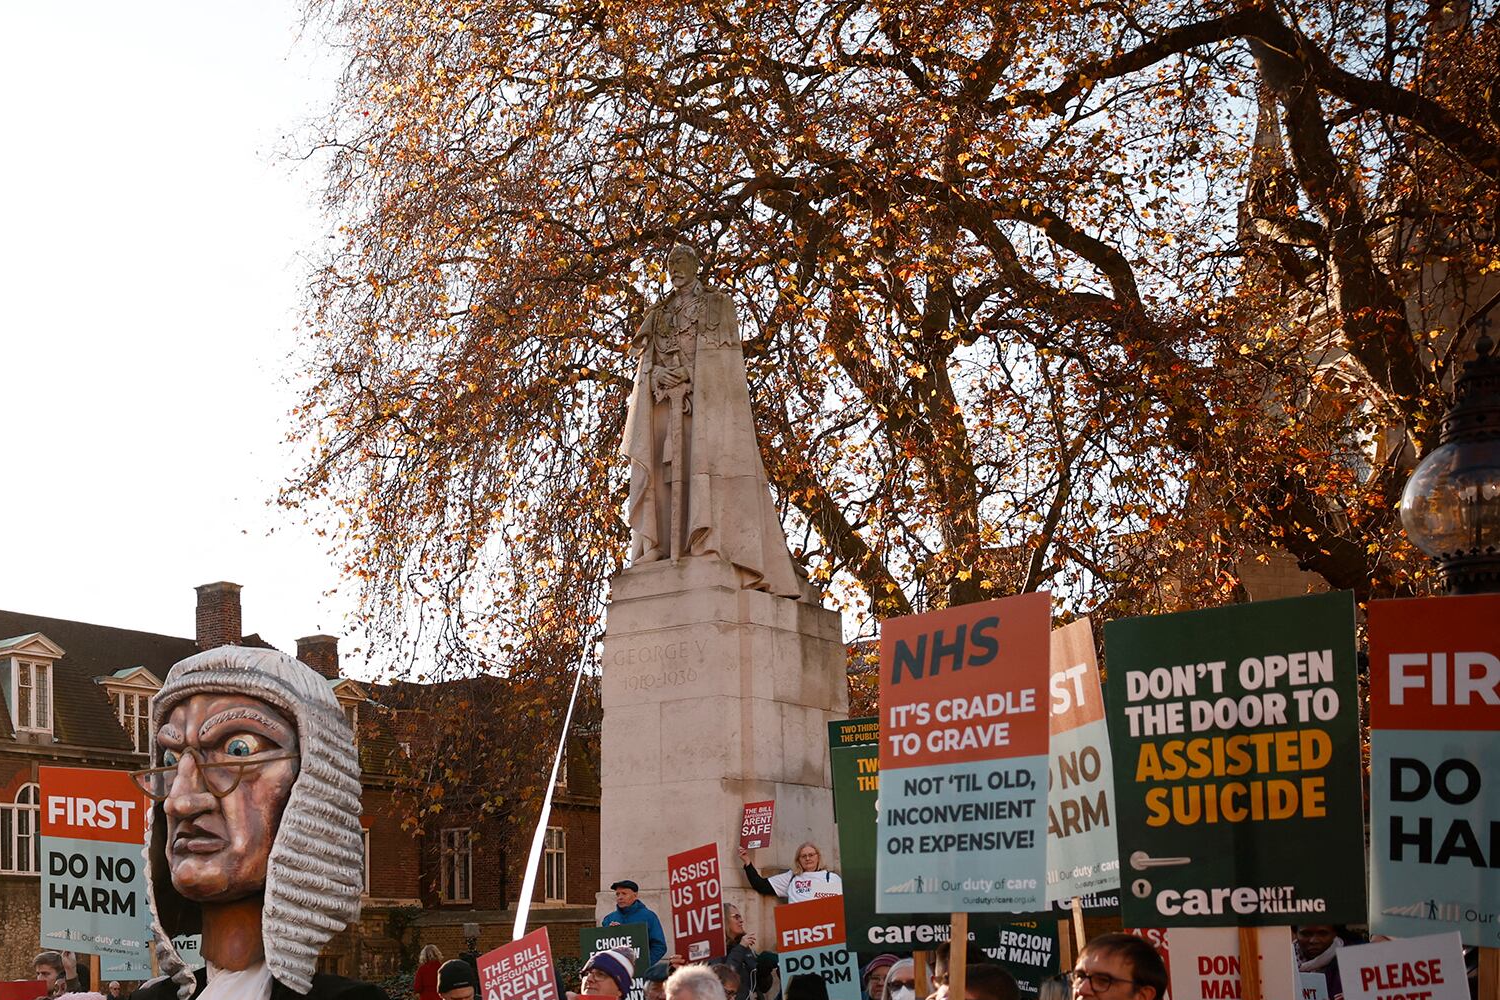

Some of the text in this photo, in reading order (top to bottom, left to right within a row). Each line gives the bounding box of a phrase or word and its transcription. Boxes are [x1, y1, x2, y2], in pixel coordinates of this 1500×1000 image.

[613, 642, 689, 666] GEORGE
[891, 616, 1000, 685] NHS
[1126, 661, 1226, 702] DON'T
[1238, 649, 1334, 691] OPEN
[890, 703, 930, 728] IT'S
[935, 689, 1036, 722] CRADLE
[1124, 687, 1340, 737] THE DOOR TO
[840, 725, 856, 734] TWO
[840, 734, 854, 743] THE
[889, 722, 1009, 756] TO GRAVE
[1058, 746, 1101, 789] NO
[1135, 729, 1332, 782] ASSISTED
[904, 777, 944, 796] NOT
[988, 769, 1036, 791] OLD,
[1390, 757, 1481, 805] DO
[48, 795, 135, 830] FIRST
[888, 799, 1036, 826] INCONVENIENT
[1145, 777, 1326, 827] SUICIDE
[742, 824, 771, 836] SAFE
[743, 816, 772, 826] ARENT
[887, 830, 1034, 855] OR EXPENSIVE!
[49, 851, 136, 883] DO NO
[671, 858, 716, 885] ASSIST
[1074, 860, 1119, 879] duty care
[672, 879, 719, 908] US TO
[942, 878, 1037, 894] Our duty of care
[1259, 886, 1294, 900] NOT
[50, 883, 136, 917] HARM
[1155, 887, 1259, 916] care
[1260, 899, 1325, 913] KILLING
[674, 904, 721, 939] LIVE
[1465, 909, 1493, 924] Our
[596, 936, 632, 950] CHOICE
[782, 923, 835, 947] FIRST
[868, 924, 934, 944] care
[483, 944, 546, 979] THE BILL
[485, 955, 547, 990] SAFEGUARDS
[785, 949, 849, 973] DO NO
[1009, 950, 1051, 968] MANY
[1360, 959, 1444, 992] PLEASE
